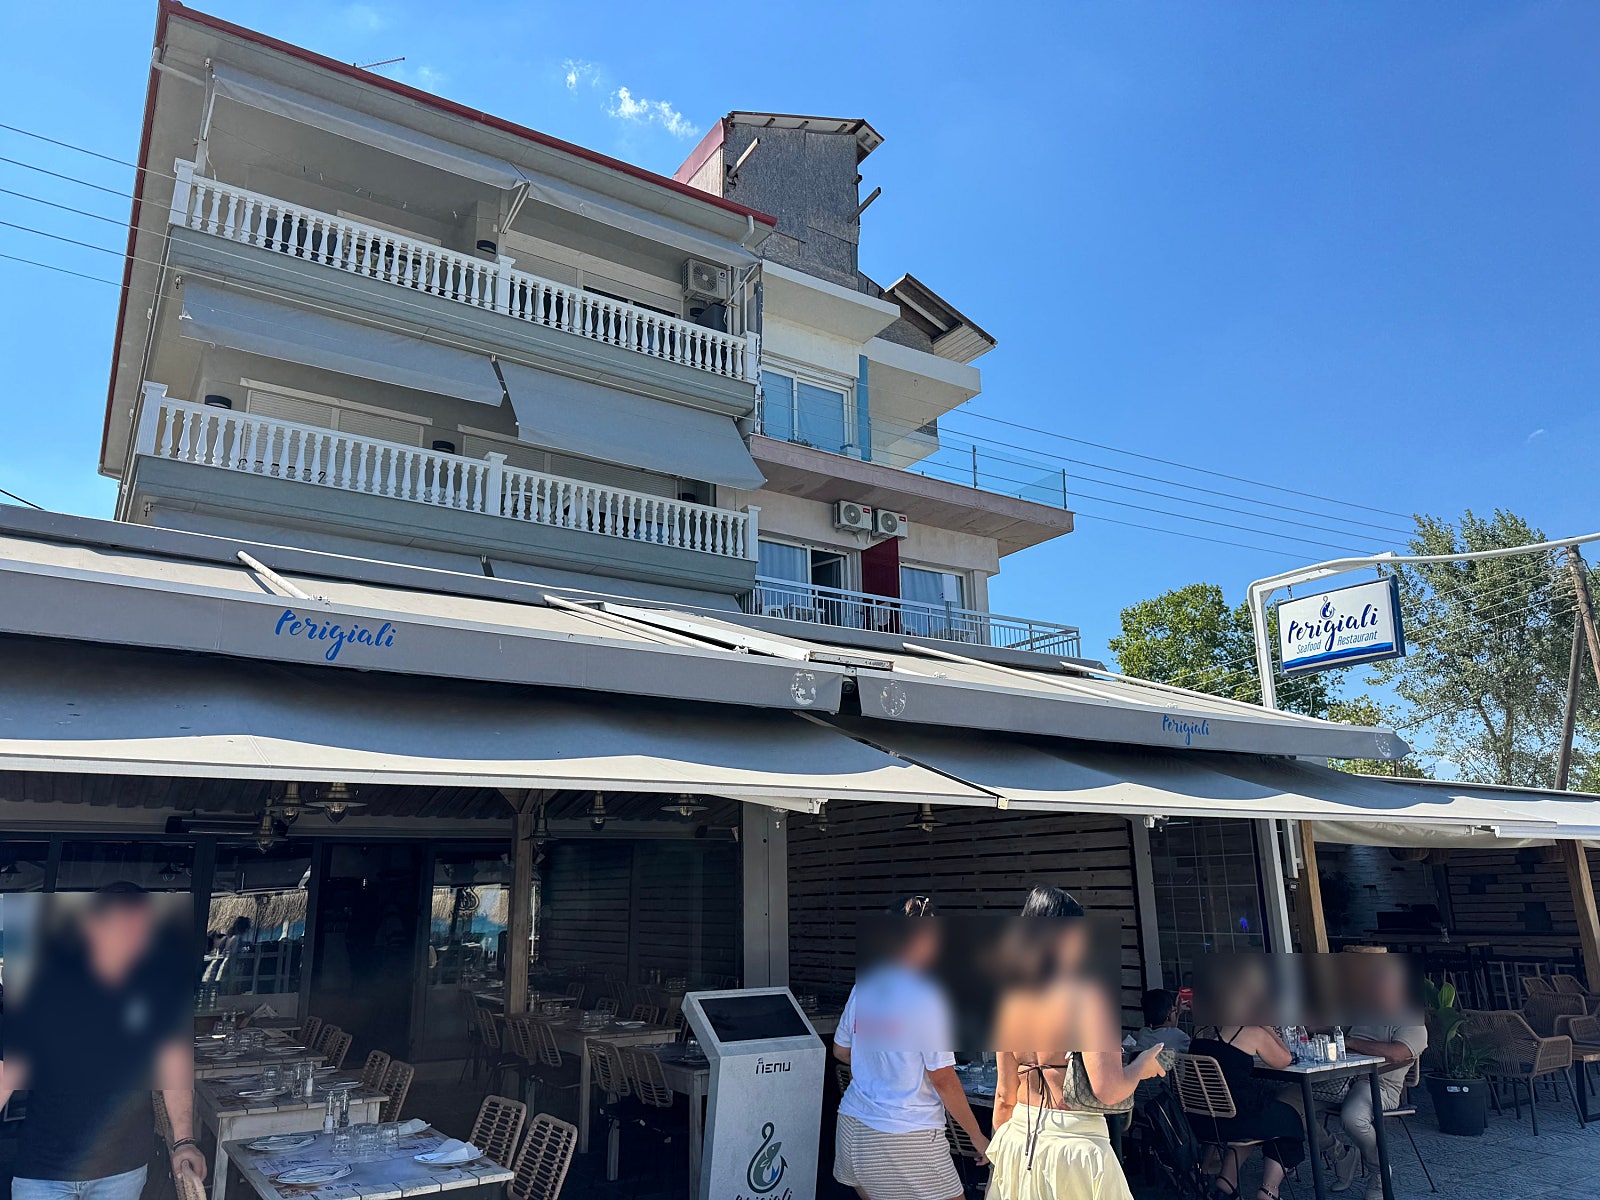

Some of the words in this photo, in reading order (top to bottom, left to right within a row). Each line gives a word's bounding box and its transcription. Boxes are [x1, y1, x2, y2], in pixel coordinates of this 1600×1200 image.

[275, 609, 397, 661] Perigiali
[1288, 603, 1379, 652] Perigiali
[1296, 640, 1322, 655] Seafood
[1336, 629, 1378, 647] Restaurant
[1162, 714, 1210, 746] Perigiali
